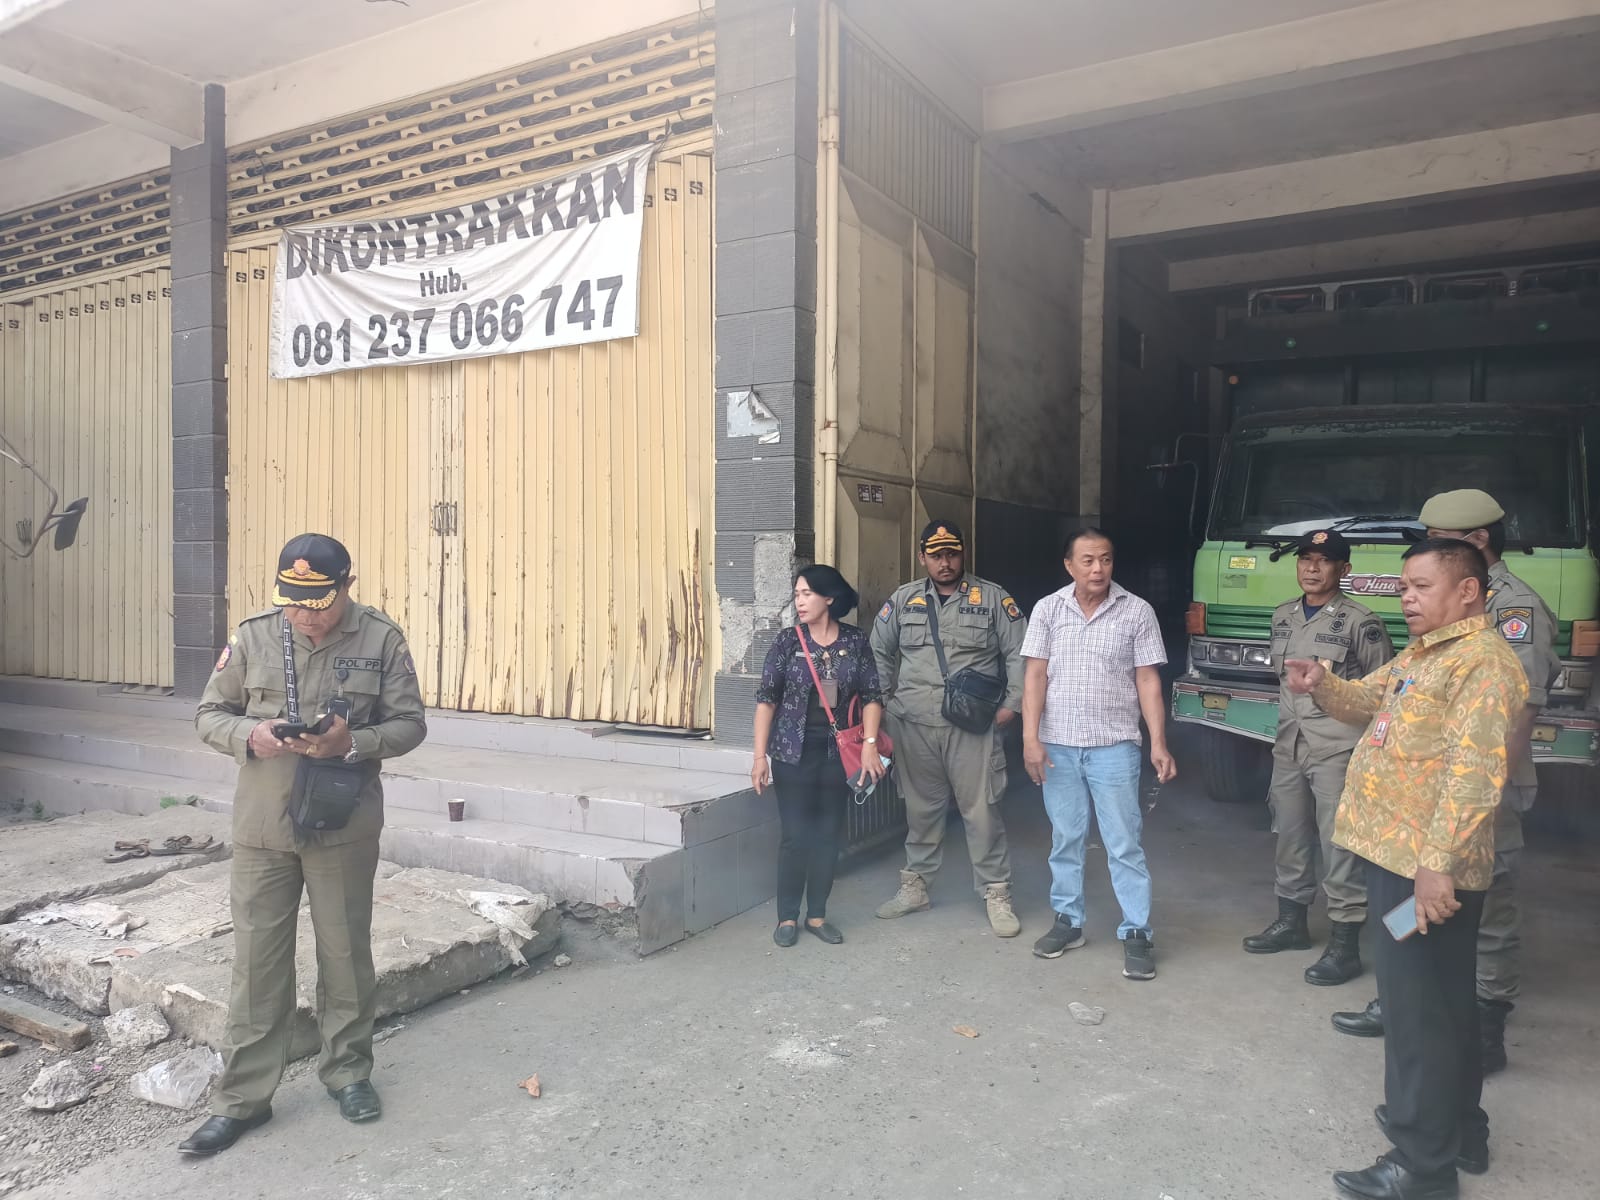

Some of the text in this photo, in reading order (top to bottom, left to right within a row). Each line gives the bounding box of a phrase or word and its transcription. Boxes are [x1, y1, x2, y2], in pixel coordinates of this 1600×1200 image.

[286, 158, 635, 280] DIKONTRAKKAN
[420, 267, 468, 298] Hub.
[292, 275, 624, 368] 081 237 066 747
[1360, 578, 1395, 592] Hino
[338, 659, 379, 669] POL PP
